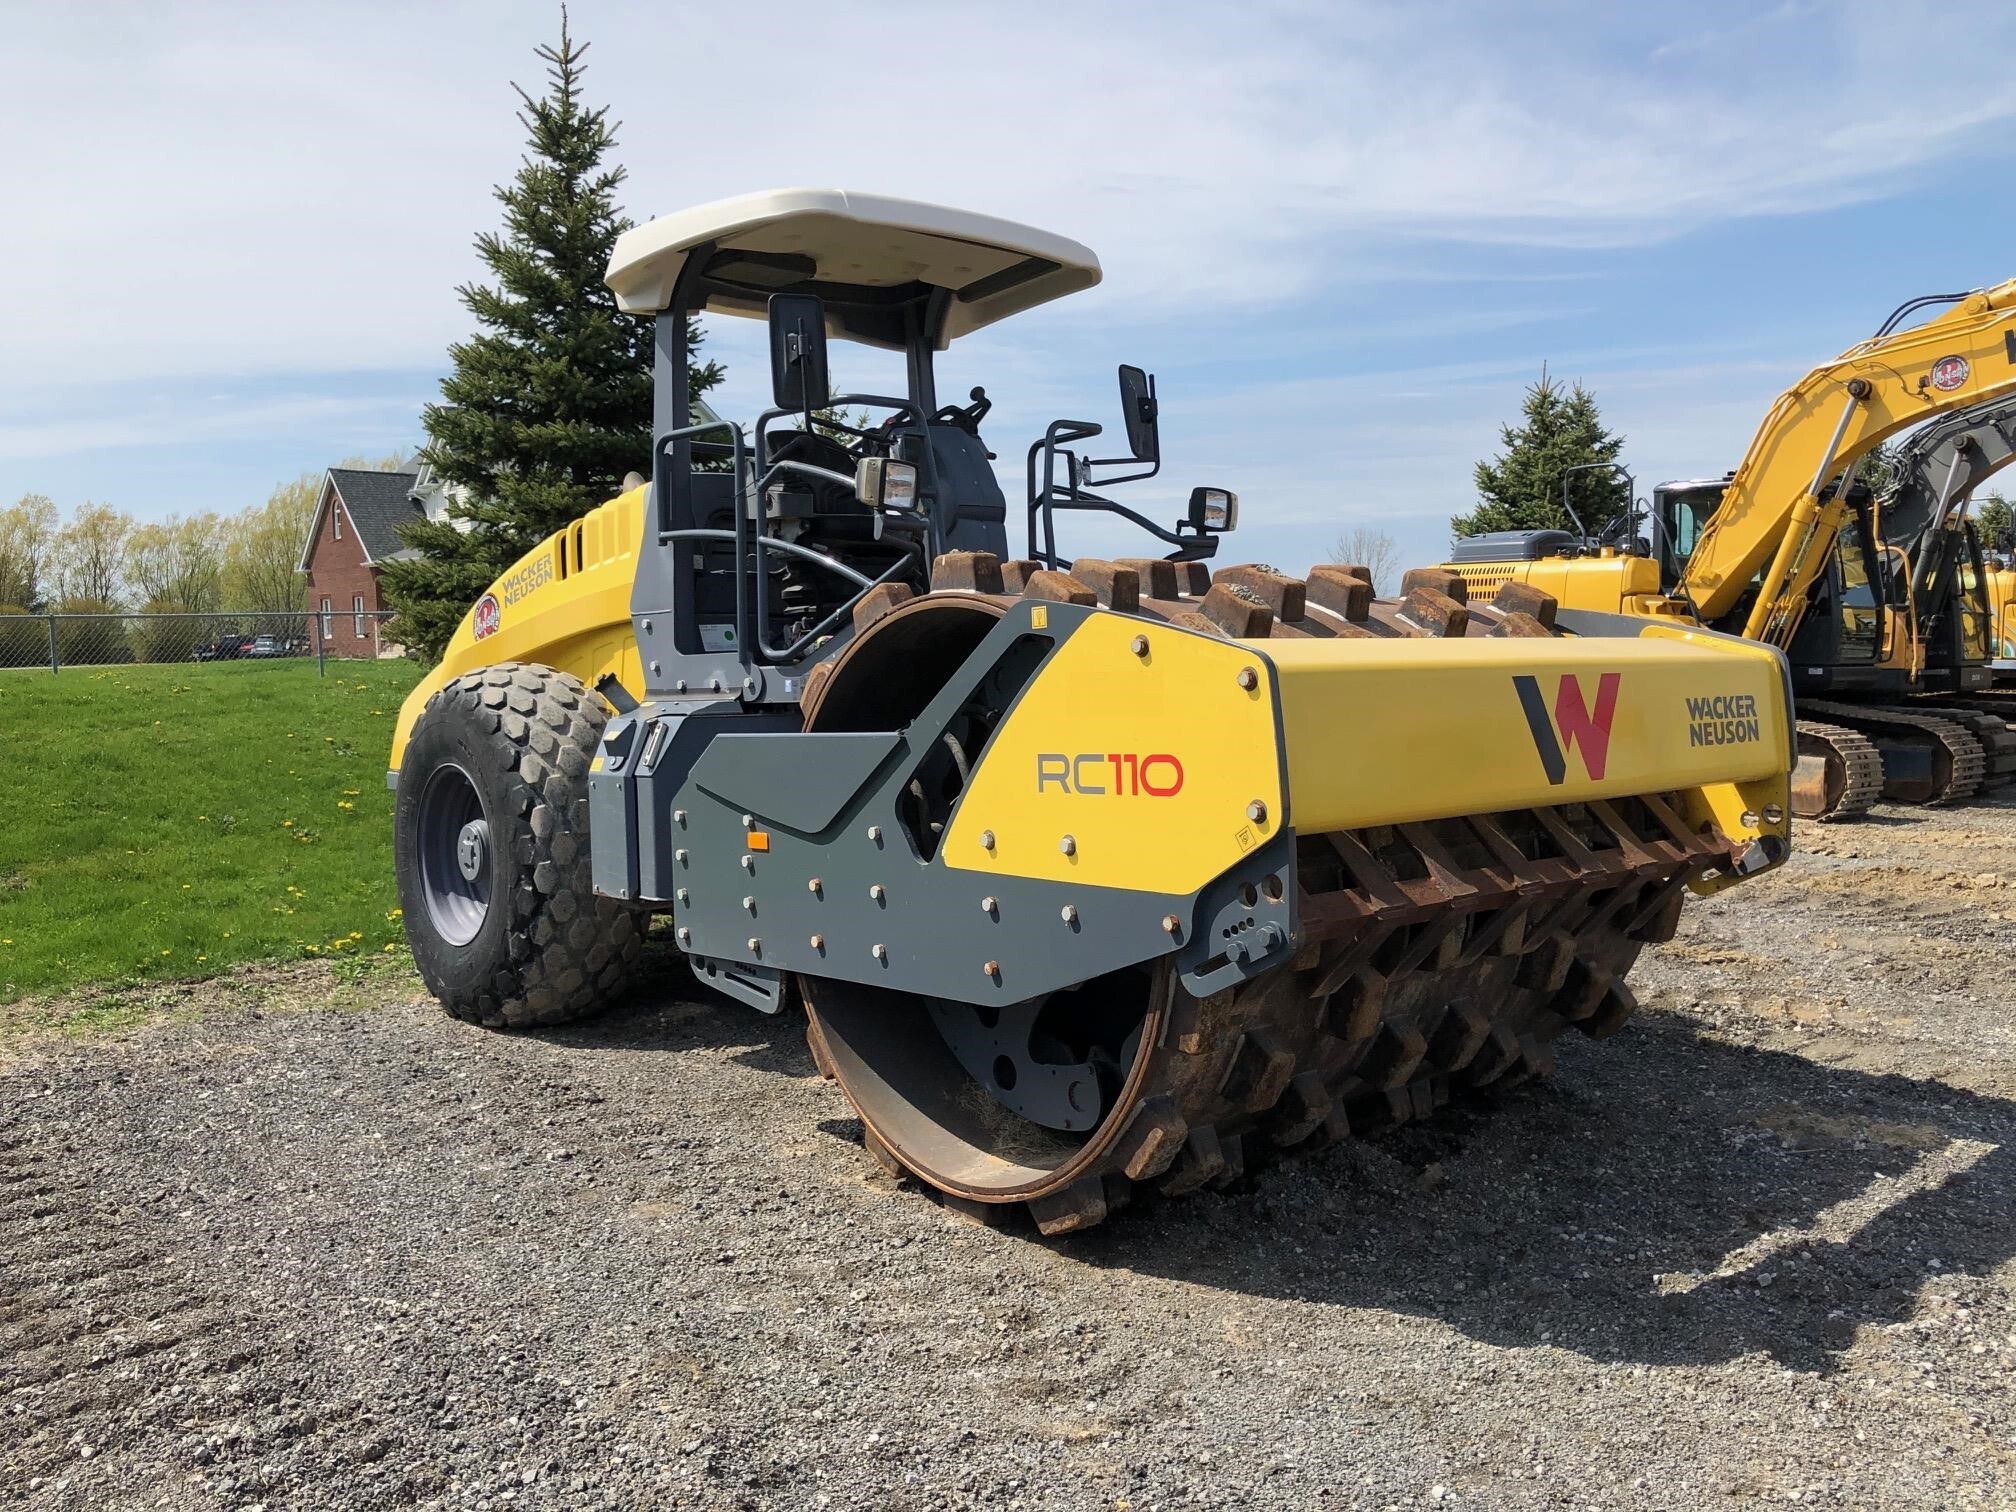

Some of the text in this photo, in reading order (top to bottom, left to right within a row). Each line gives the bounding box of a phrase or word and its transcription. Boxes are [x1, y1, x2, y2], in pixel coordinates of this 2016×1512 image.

[502, 553, 552, 594] WACKER
[504, 566, 553, 609] NEUSON
[1685, 694, 1758, 722] WACKER
[1689, 719, 1761, 748] NEUSON
[1037, 753, 1184, 797] RC110
